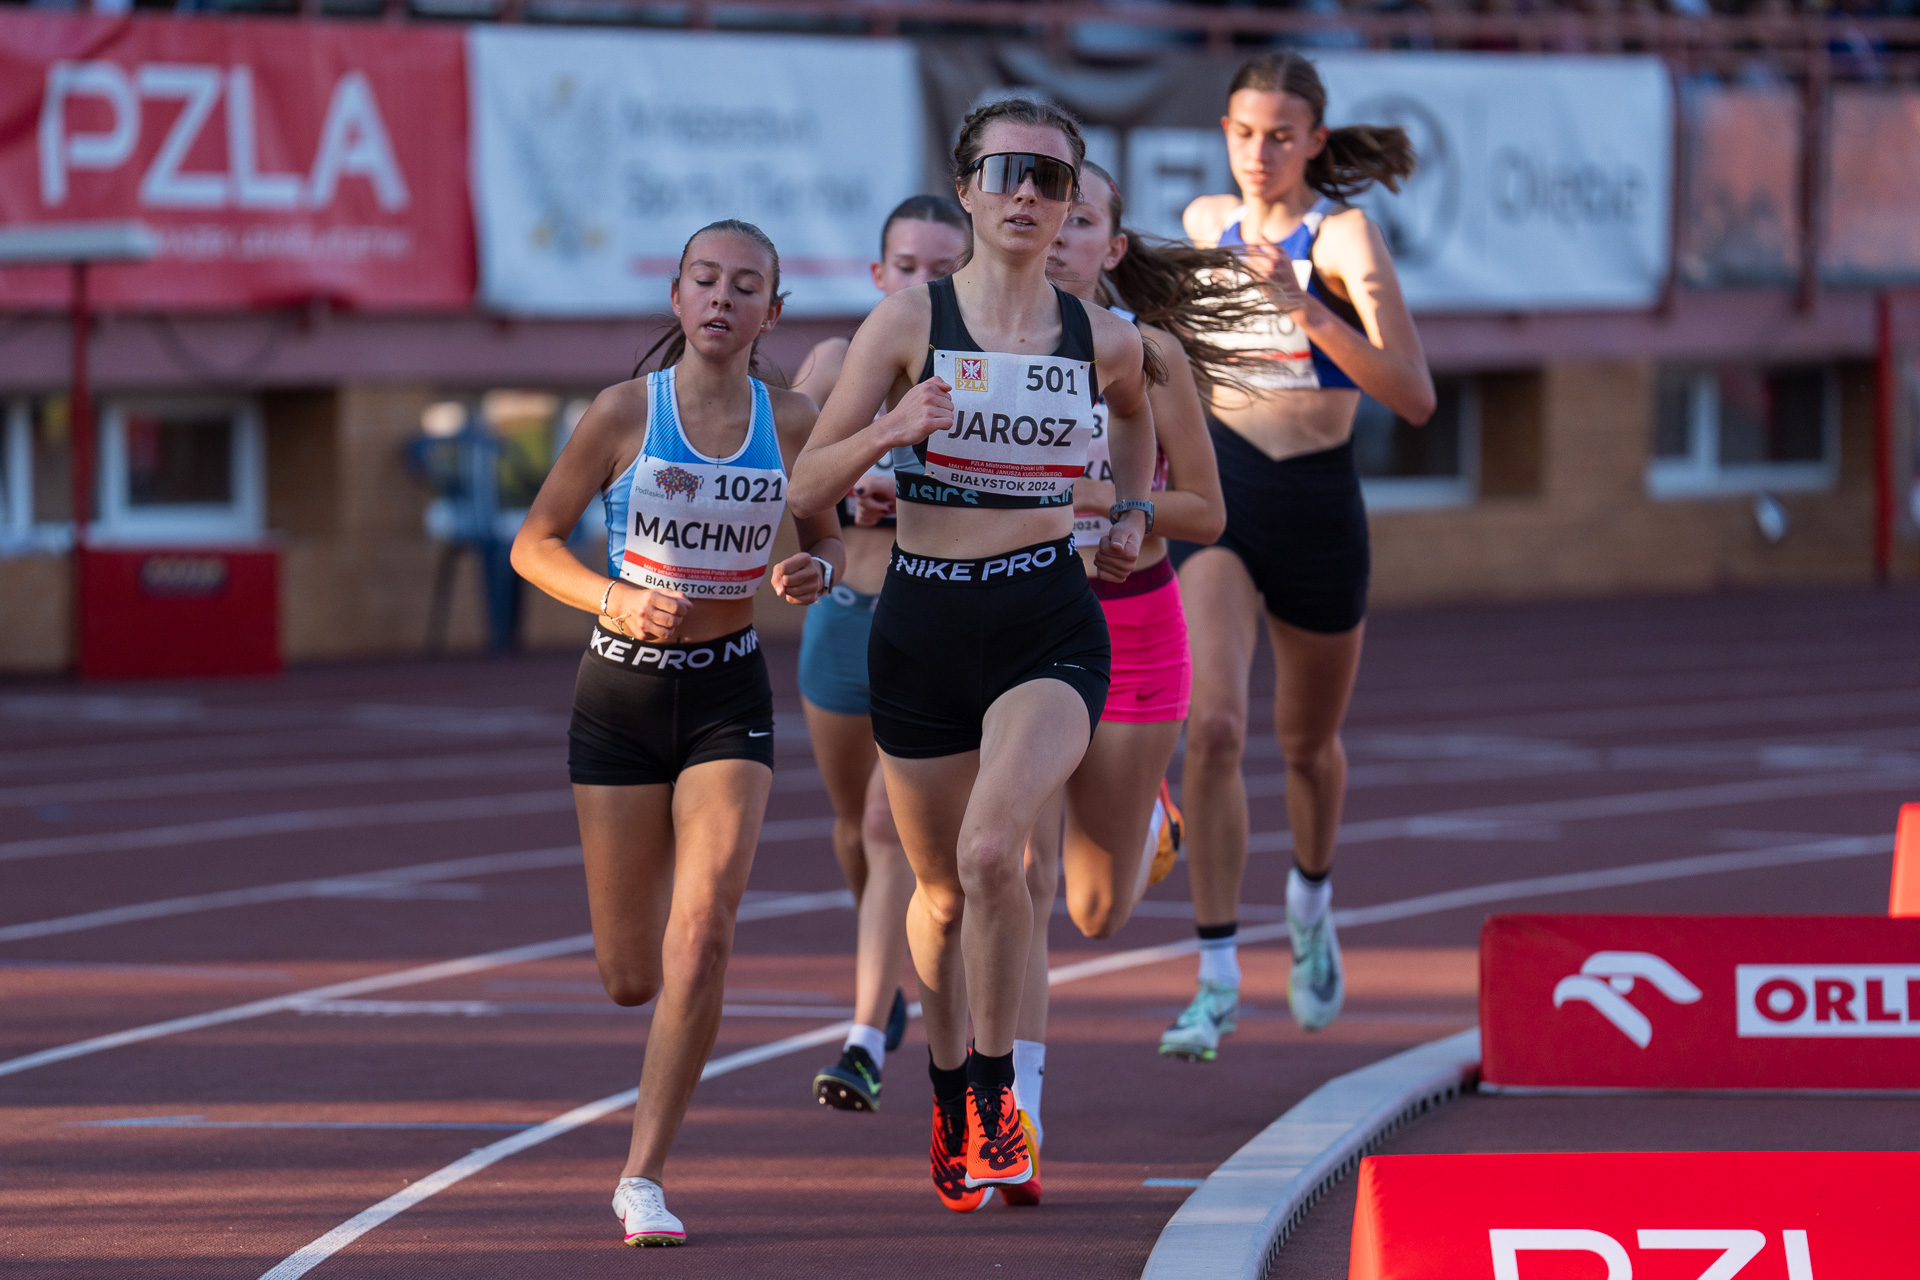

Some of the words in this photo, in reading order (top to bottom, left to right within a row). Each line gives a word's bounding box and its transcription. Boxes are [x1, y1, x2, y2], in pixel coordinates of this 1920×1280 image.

[38, 62, 410, 209] PZLA
[957, 379, 987, 391] PZLA
[1026, 365, 1078, 396] 501
[948, 410, 1077, 447] JAROSZ
[948, 462, 964, 471] MAŁY
[965, 466, 995, 475] MEMORIAŁ
[996, 469, 1022, 478] JANUSZA
[985, 462, 1020, 471] Mistrzostwa
[635, 485, 666, 499] Podlaskie
[714, 474, 783, 503] 1021
[951, 472, 1026, 491] BIAŁYSTOK
[1027, 481, 1057, 491] 2024
[908, 482, 979, 505] ASICS
[635, 511, 771, 553] MACHNIO
[663, 564, 677, 572] PZLA
[896, 555, 976, 581] NIKE
[981, 546, 1057, 581] PRO
[645, 574, 716, 595] BIAŁYSTOK
[718, 584, 748, 595] 2024
[631, 646, 715, 670] PRO
